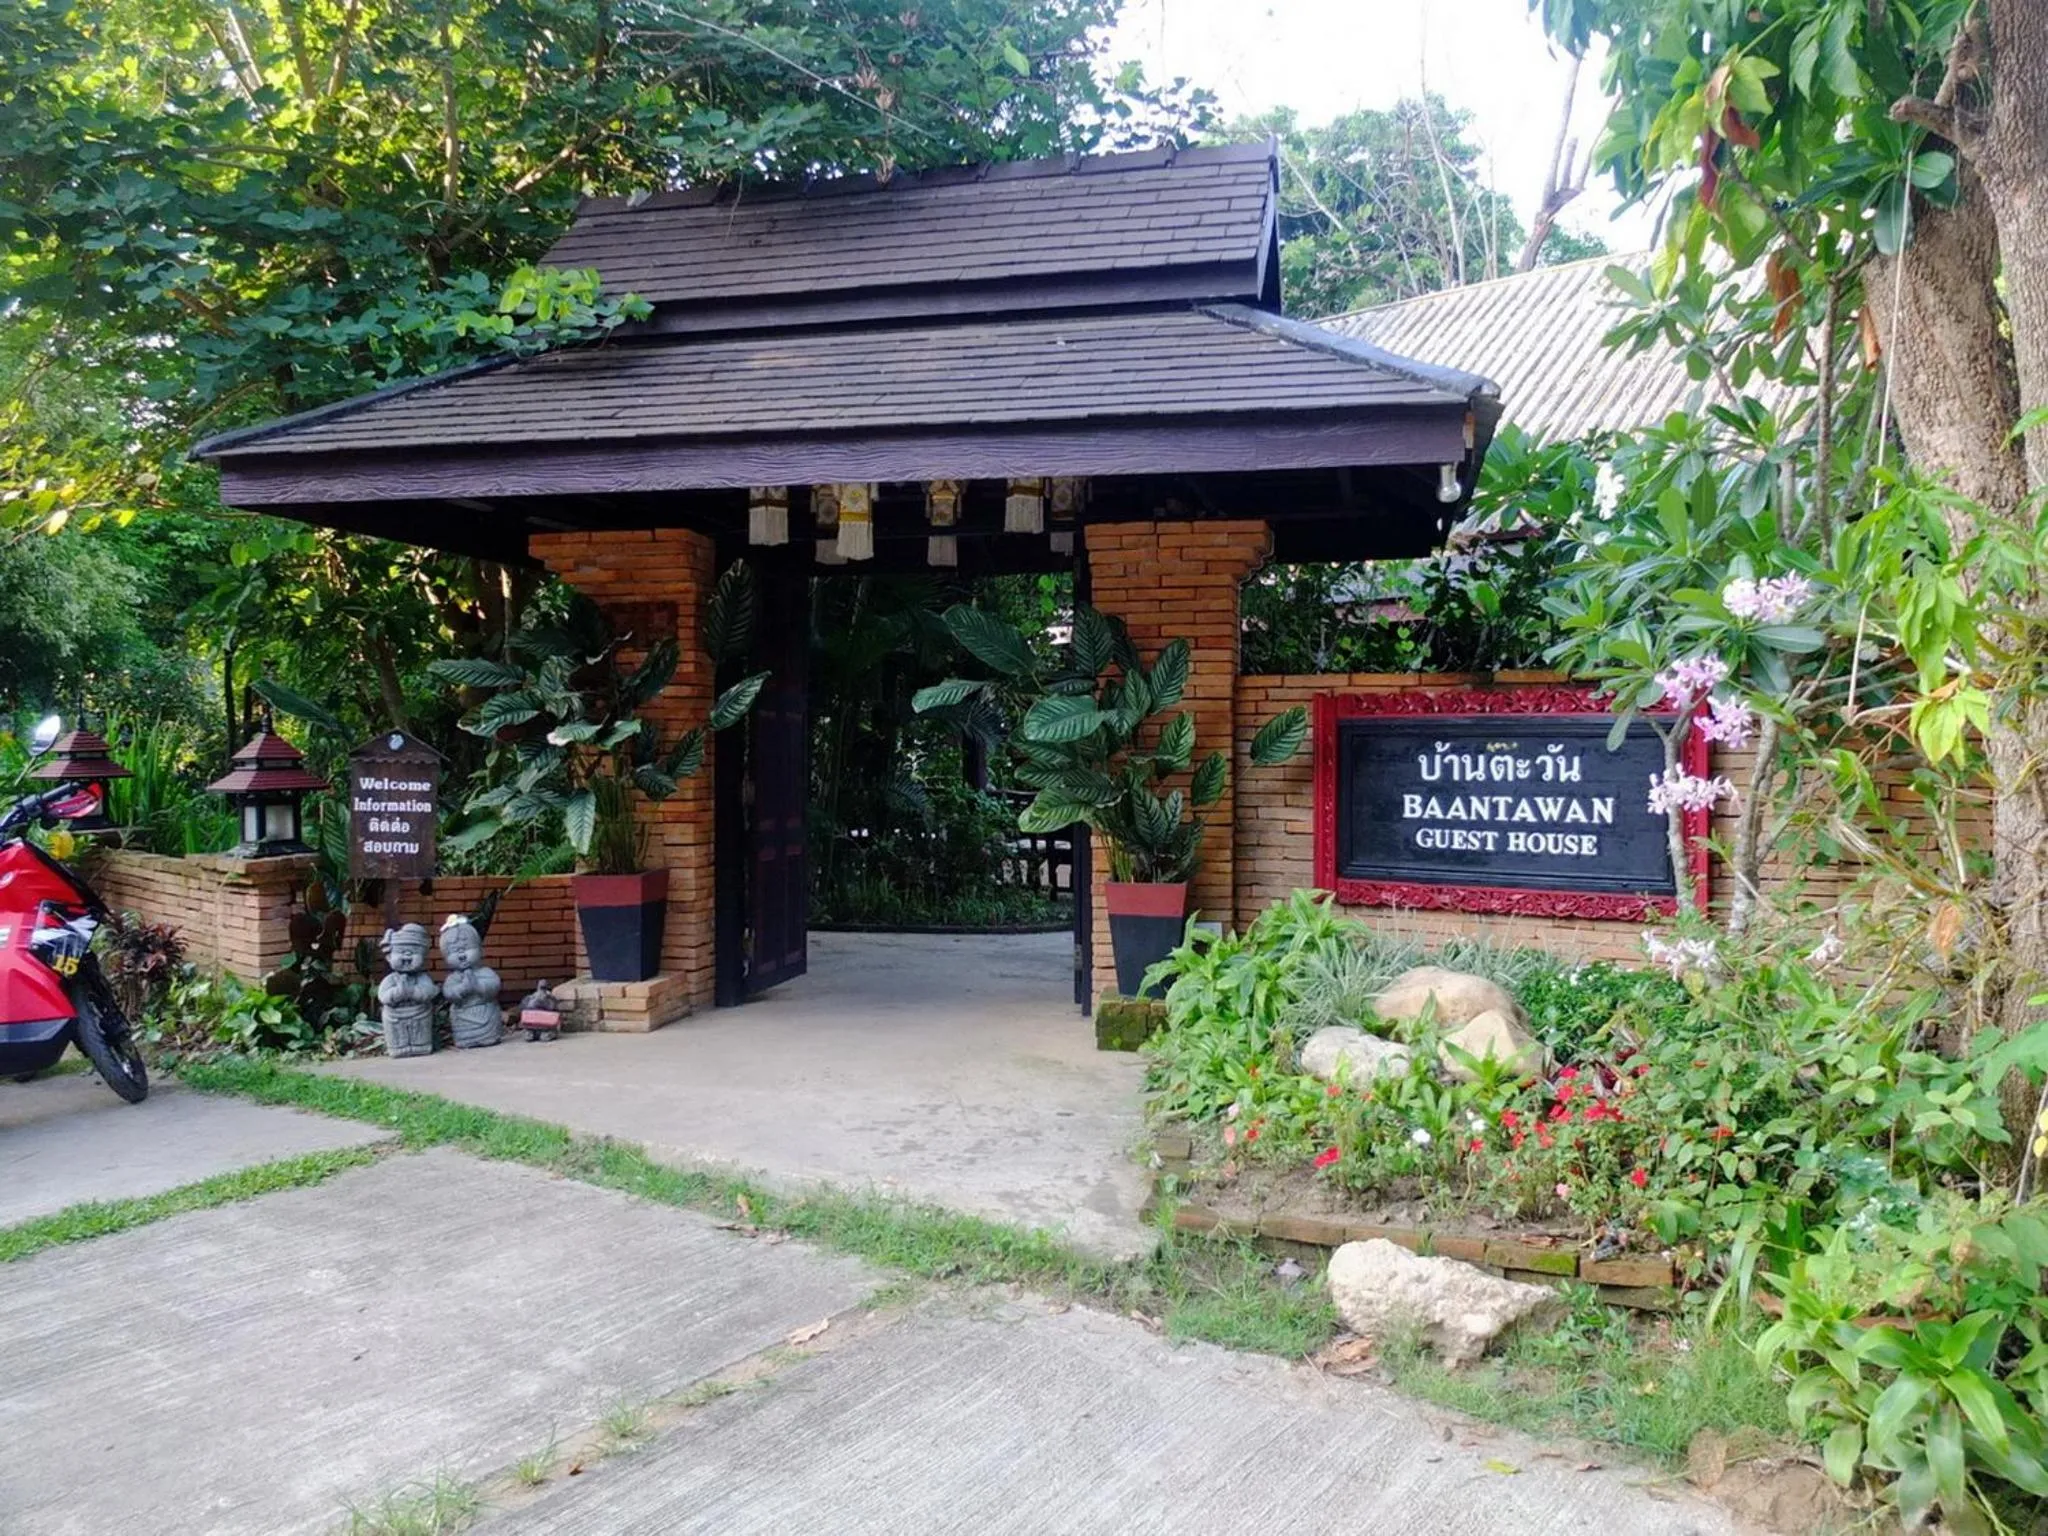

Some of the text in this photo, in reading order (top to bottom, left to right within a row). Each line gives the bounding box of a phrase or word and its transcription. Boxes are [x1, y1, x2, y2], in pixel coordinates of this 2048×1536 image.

[359, 777, 432, 791] Welcome
[354, 797, 432, 812] Information
[1402, 794, 1614, 823] BAANTAWAN
[363, 840, 420, 853] สอบถาม
[1416, 828, 1598, 855] GUEST HOUSE
